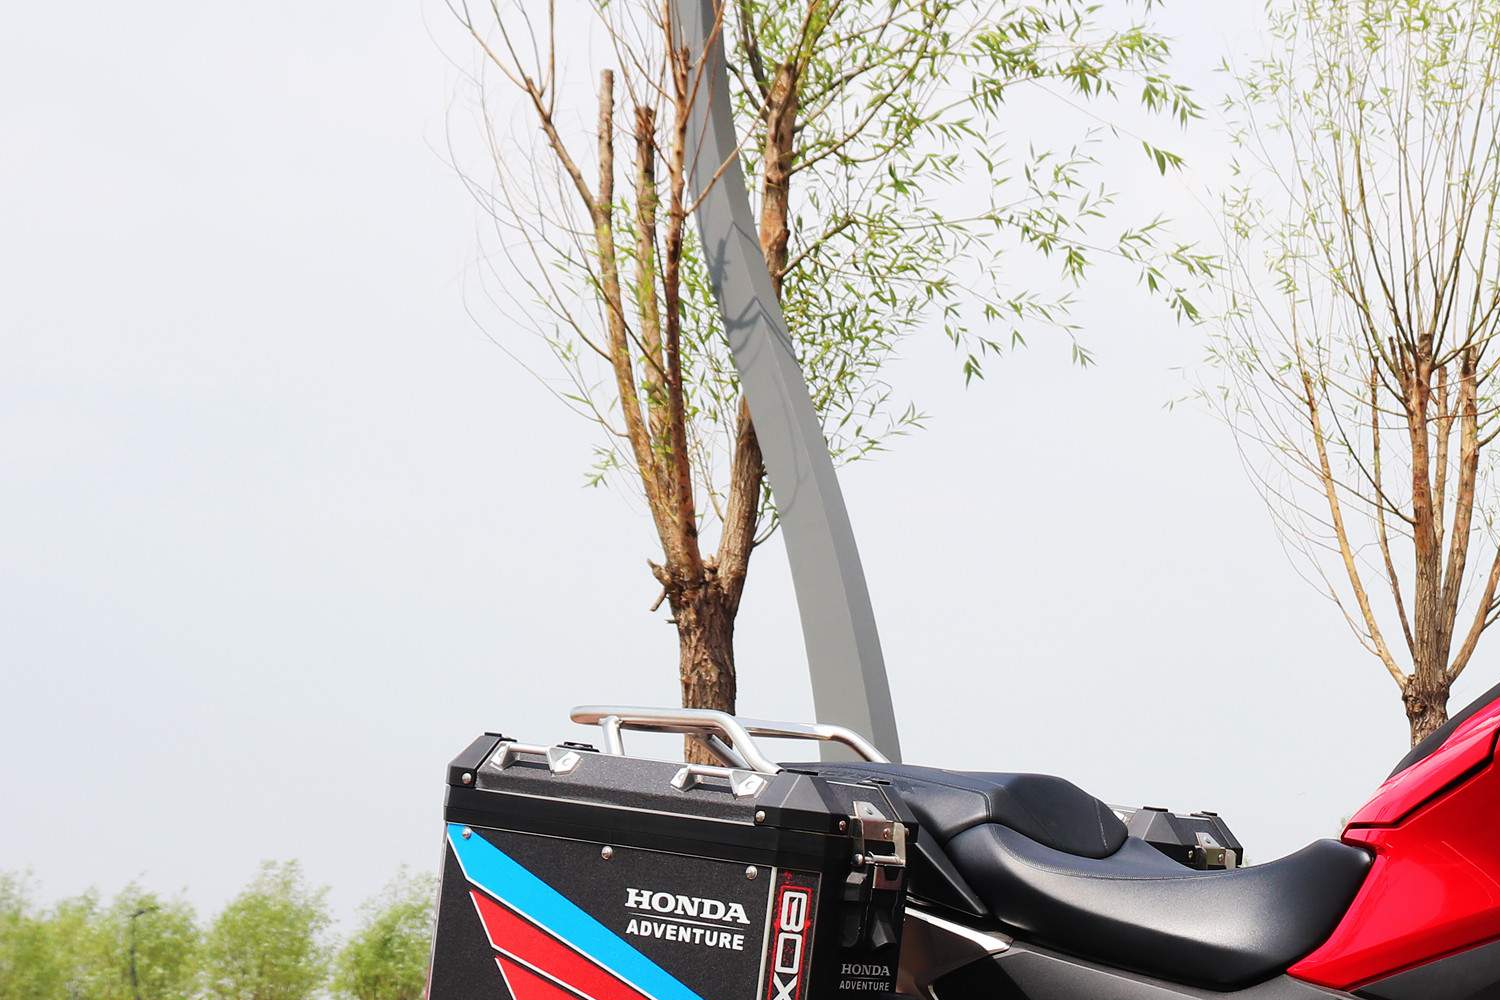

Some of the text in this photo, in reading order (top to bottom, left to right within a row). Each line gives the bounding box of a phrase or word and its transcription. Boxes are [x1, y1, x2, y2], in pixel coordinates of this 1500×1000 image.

[624, 887, 751, 925] HONDA
[625, 918, 745, 951] ADVENTURE
[840, 963, 890, 976] HONDA
[839, 980, 890, 991] ADVENTURE
